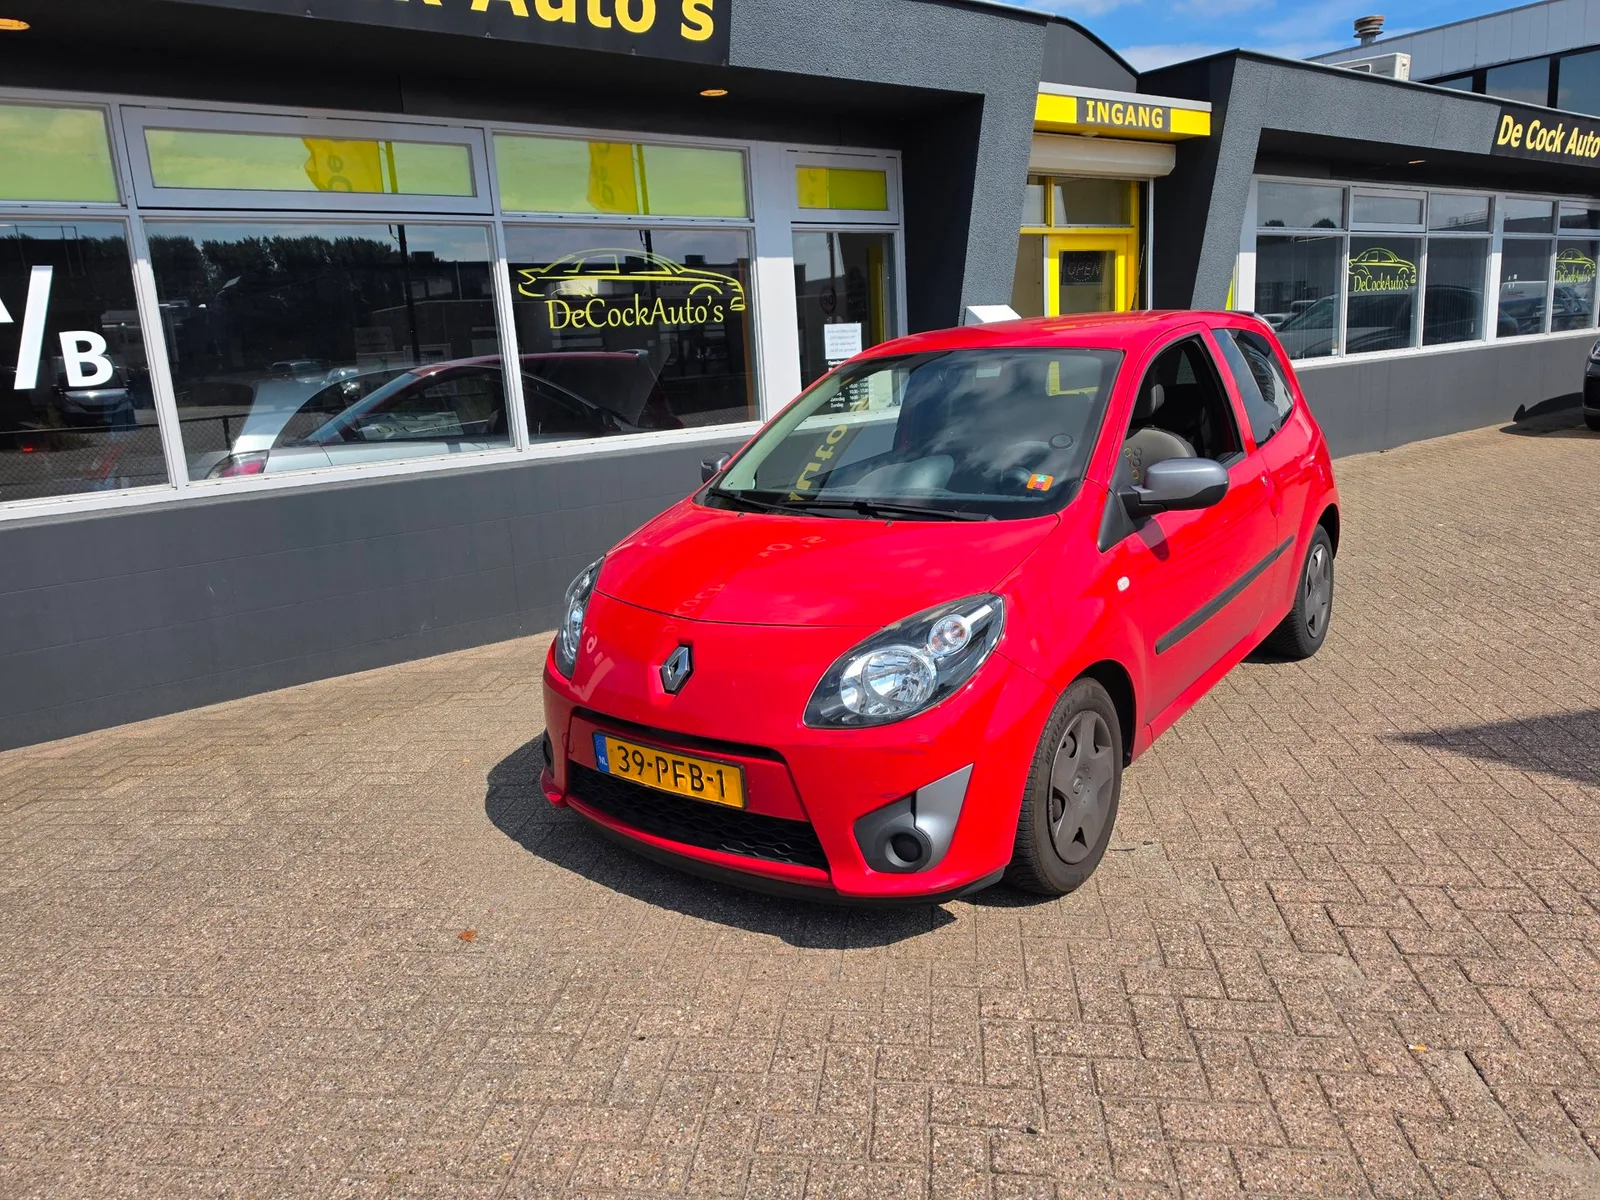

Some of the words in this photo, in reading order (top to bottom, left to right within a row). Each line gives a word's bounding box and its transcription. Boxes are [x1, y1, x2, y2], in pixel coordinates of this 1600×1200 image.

[1086, 100, 1163, 129] INGANG
[1496, 114, 1524, 148] De
[1525, 119, 1566, 153] Cock
[1353, 272, 1409, 293] DeCockAuto's
[544, 293, 724, 330] DeCockAuto's
[598, 755, 608, 766] NL
[616, 745, 726, 798] 39-PFB-1
